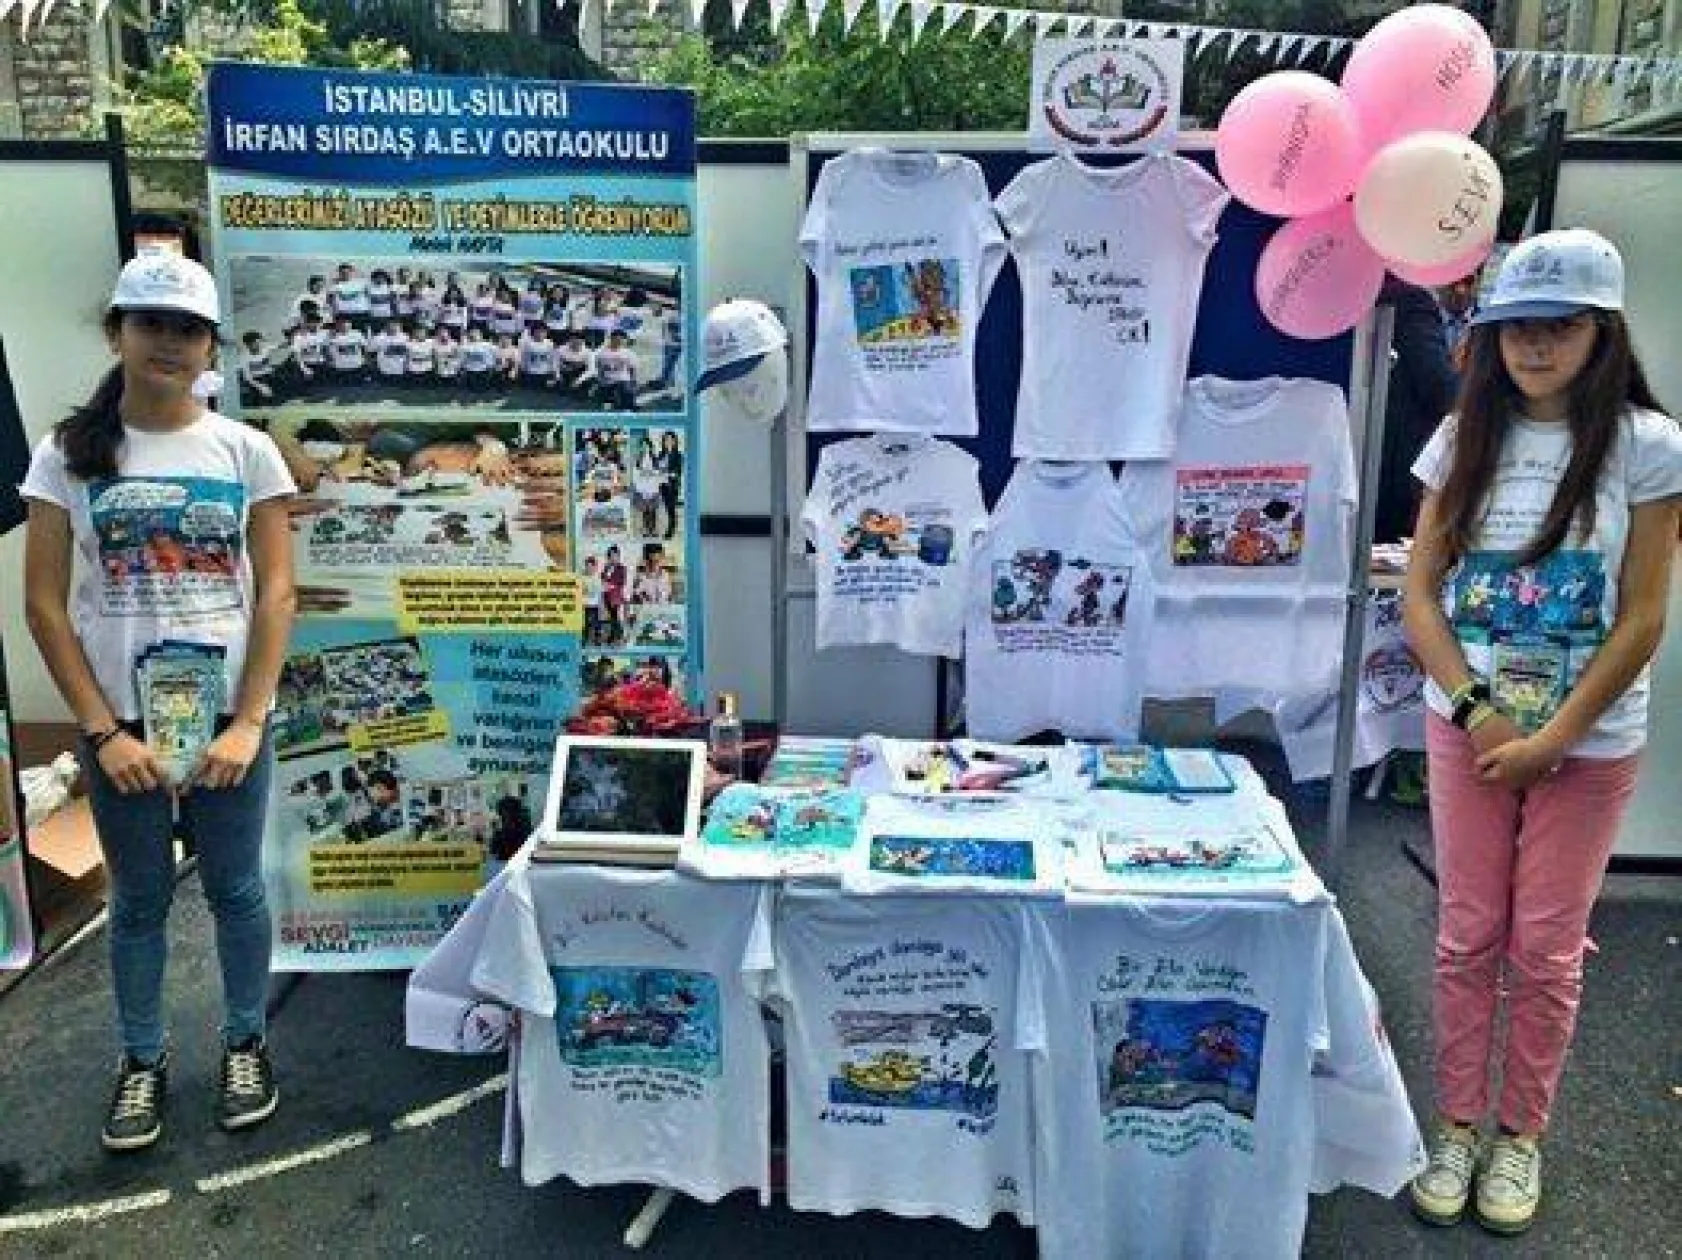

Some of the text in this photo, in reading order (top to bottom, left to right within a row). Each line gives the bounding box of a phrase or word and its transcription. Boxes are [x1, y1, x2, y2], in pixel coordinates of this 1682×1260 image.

[324, 80, 568, 118] İSTANBUL-SİLİVRİ
[225, 117, 669, 160] İRFAN SIRDAŞ A.E.V ORTAOKULU
[469, 639, 570, 663] Her ulusun
[456, 734, 478, 747] ve
[303, 940, 371, 955] ADALET
